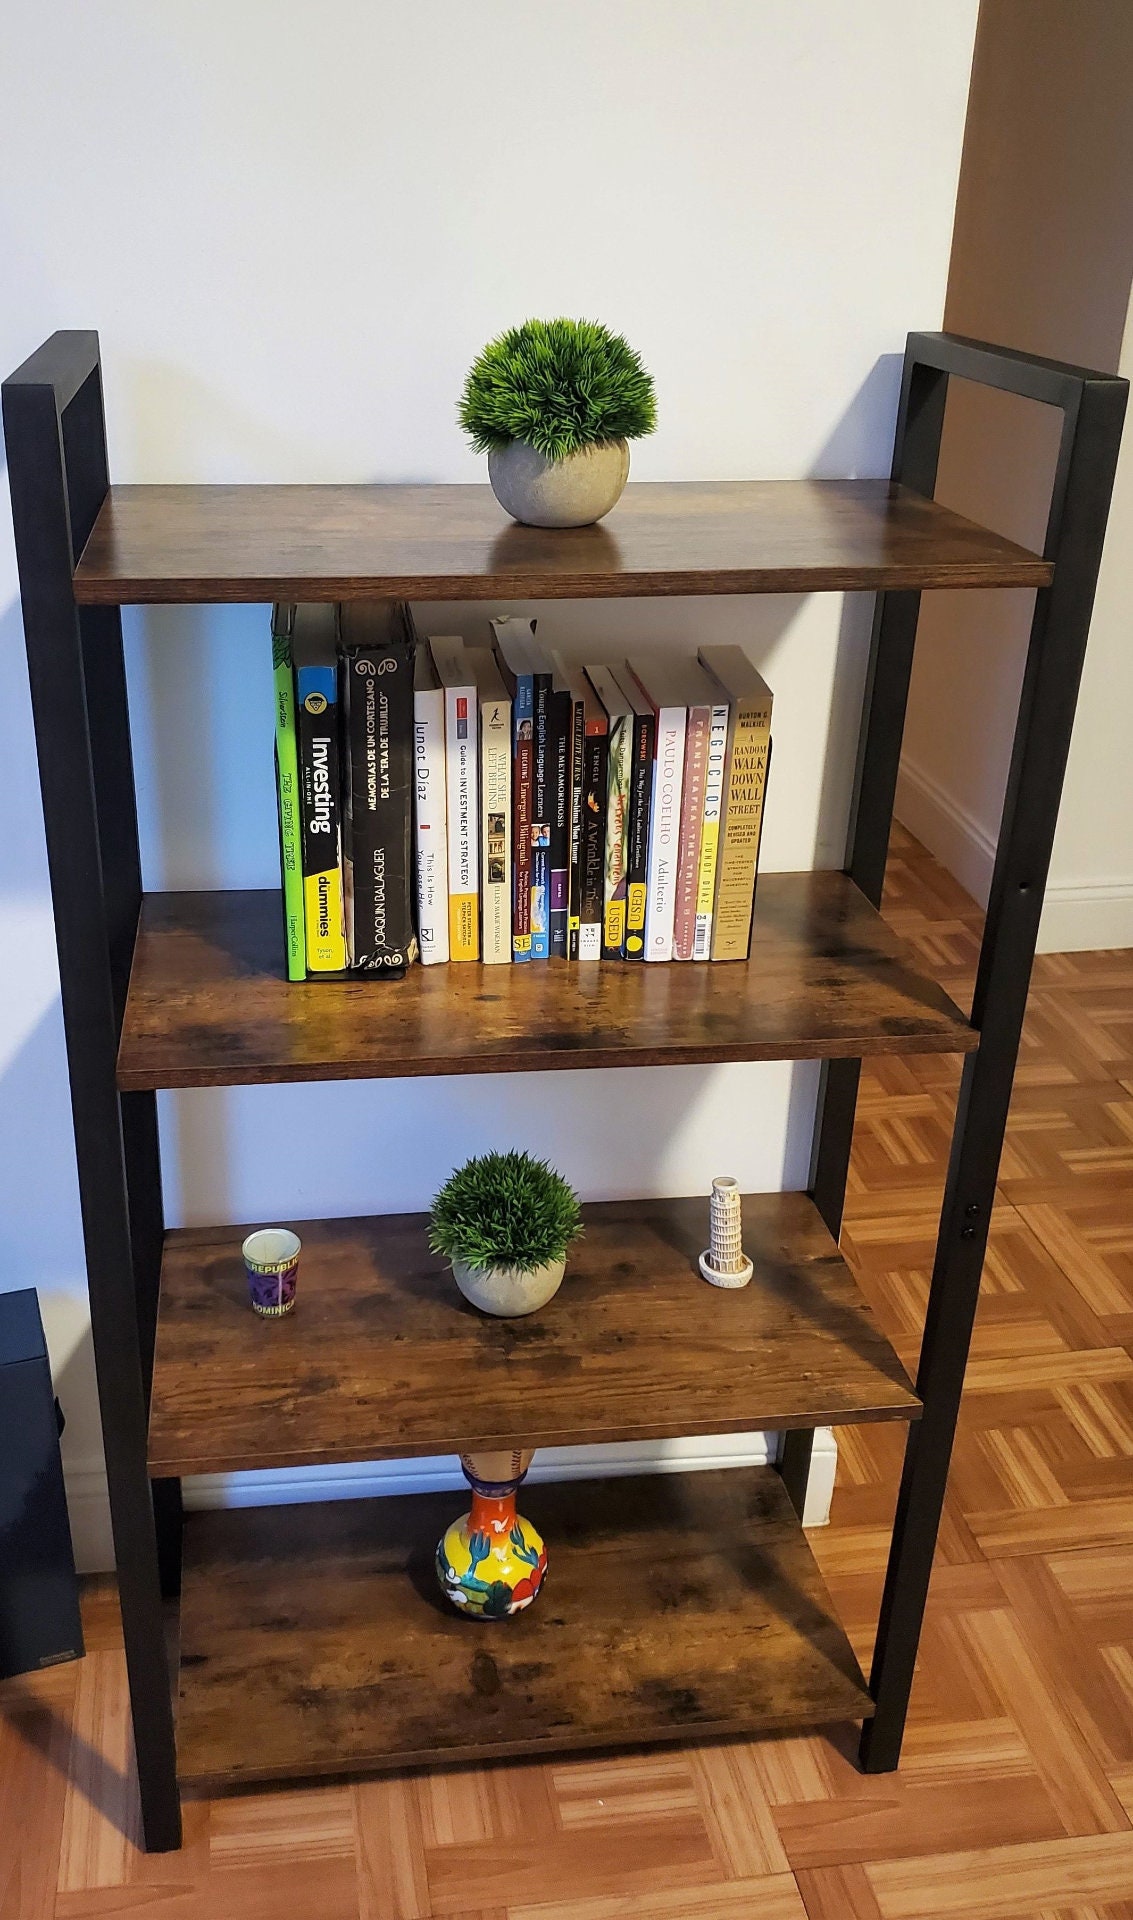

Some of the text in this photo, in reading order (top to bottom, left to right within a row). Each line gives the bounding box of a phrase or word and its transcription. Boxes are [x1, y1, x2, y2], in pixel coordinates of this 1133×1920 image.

[366, 679, 377, 810] MEMORIAS DE UN CORTESANO
[380, 738, 389, 749] DE
[574, 707, 583, 756] MARGUERITE
[694, 720, 704, 769] FRANZ
[734, 745, 767, 756] RANDOM
[414, 722, 430, 800] Junot Díaz
[460, 768, 466, 776] to
[536, 688, 548, 818] Young English Language Learners
[705, 710, 726, 817] NEGOCIOS
[734, 757, 764, 770] WALK
[310, 738, 334, 834] Investing
[380, 774, 390, 786] LA
[380, 787, 390, 798] DE
[488, 748, 498, 810] LEFT BEHIND
[498, 752, 506, 802] WHAT SHE
[660, 730, 676, 844] PAULO COELHO
[731, 788, 761, 801] WALL
[732, 772, 764, 786] DOWN
[460, 778, 468, 836] INVESTMENT
[518, 782, 530, 822] Emergent
[572, 787, 582, 823] Hiroshima
[690, 776, 700, 822] KAFKA
[728, 804, 760, 815] STREET
[284, 773, 296, 871] THE GIVING TREE
[572, 824, 580, 840] Mon
[460, 841, 468, 886] STRATEGY
[517, 824, 529, 866] Bilinguals
[572, 841, 580, 864] Amour
[704, 843, 712, 873] JUNOT
[586, 822, 600, 914] A Wrinkle in Time
[656, 858, 670, 912] Adulterio
[685, 865, 694, 902] TRIAL
[318, 876, 332, 938] dummies
[374, 848, 386, 946] JOAQUIN BALAGUER
[630, 890, 642, 922] USED
[514, 938, 530, 949] SE
[609, 907, 620, 941] USED
